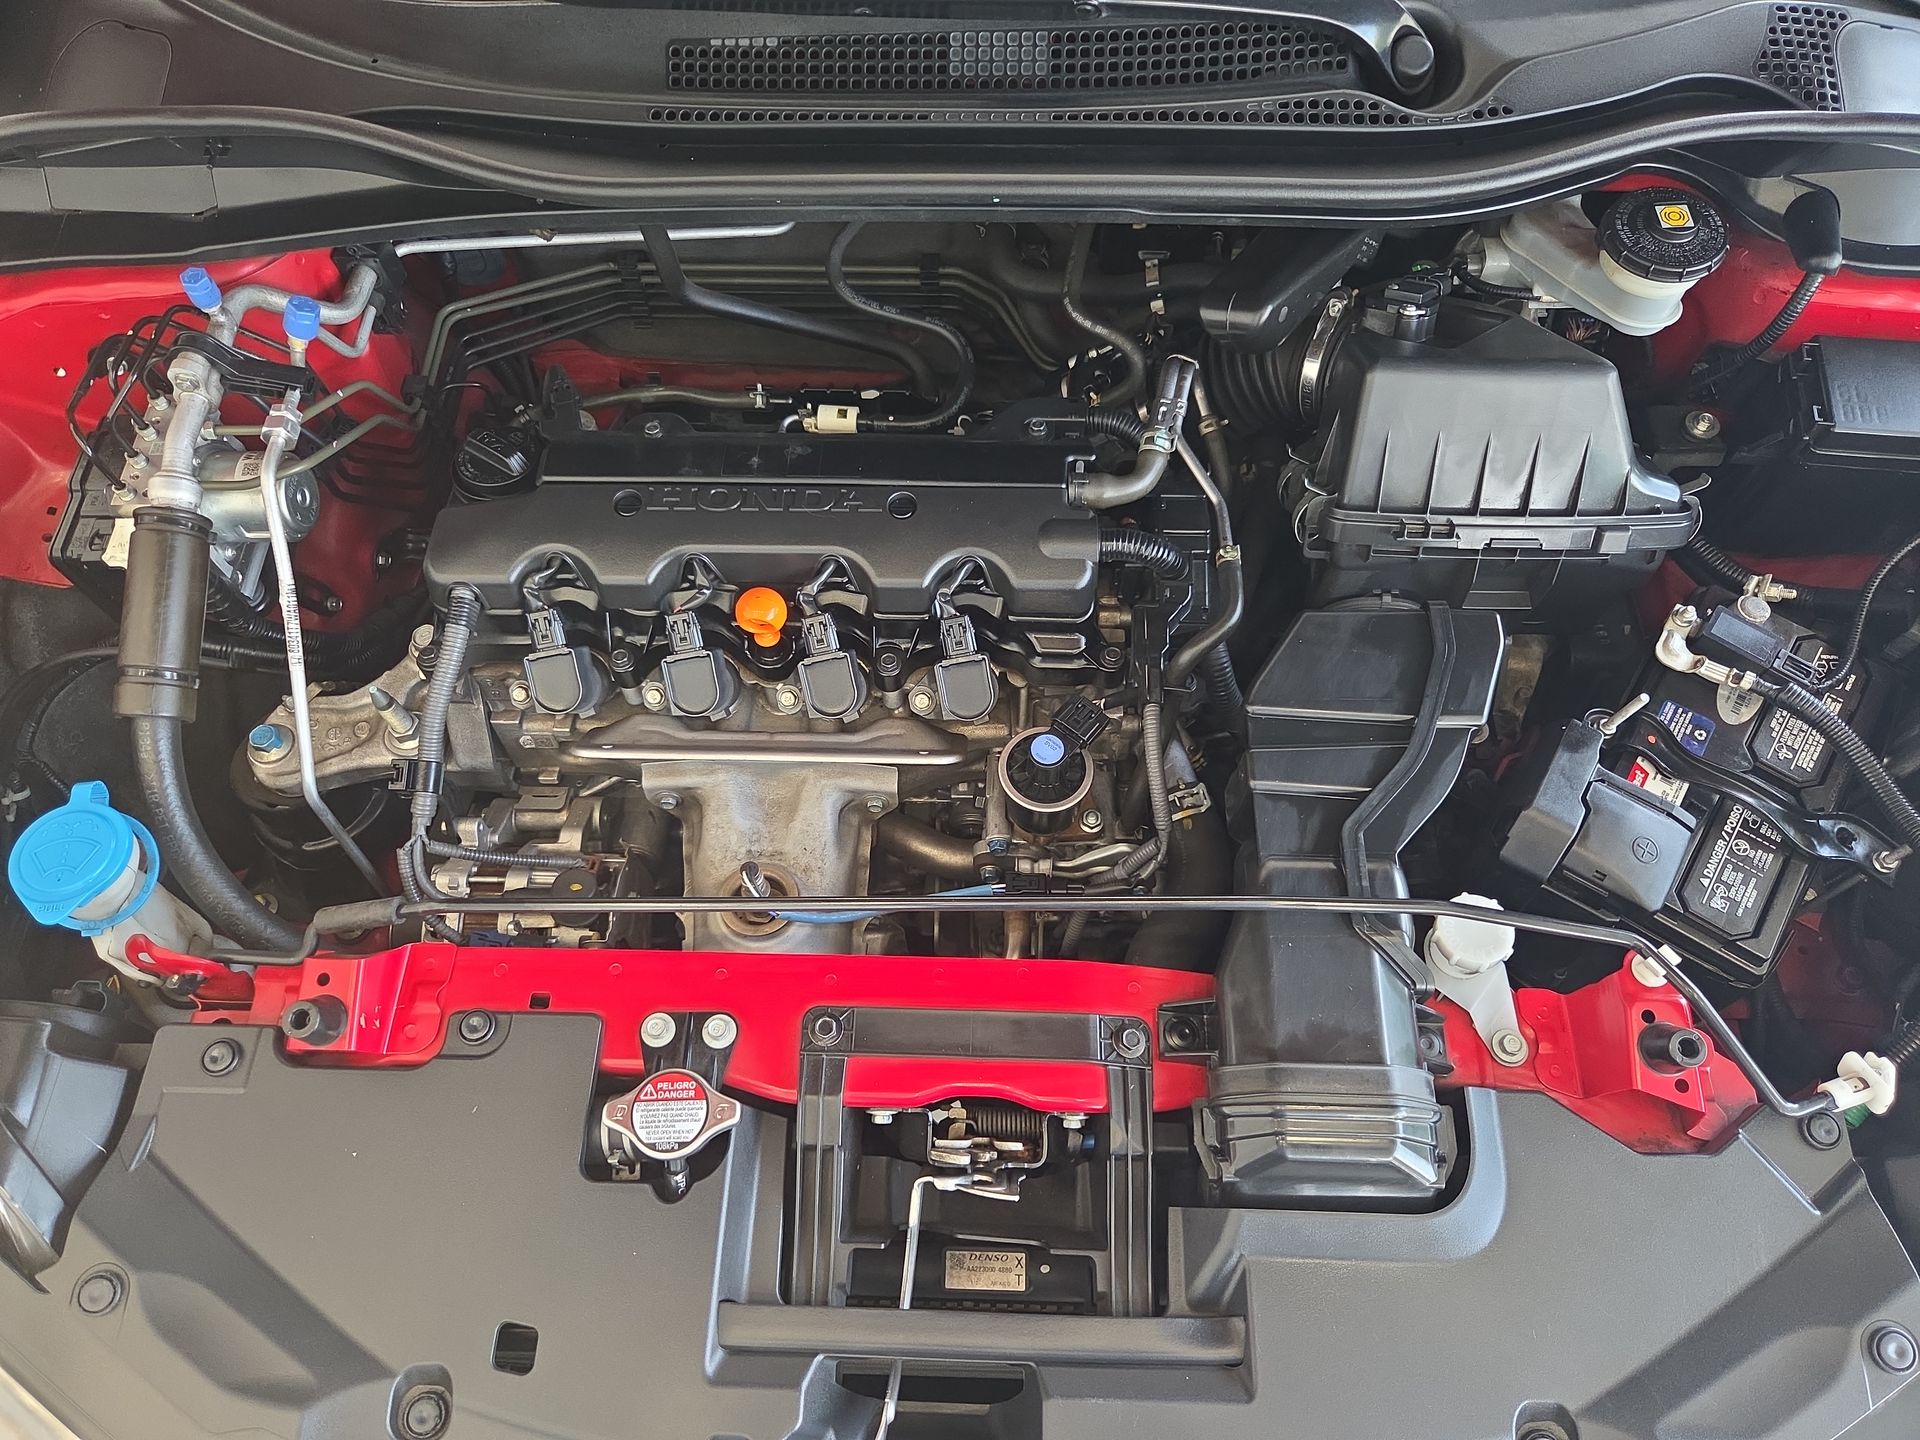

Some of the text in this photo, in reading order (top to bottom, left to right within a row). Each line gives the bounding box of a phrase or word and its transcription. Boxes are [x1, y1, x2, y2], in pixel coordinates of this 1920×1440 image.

[647, 487, 882, 512] HONDA
[1704, 840, 1727, 878] DANGER
[1724, 804, 1744, 833] POISO
[1729, 872, 1744, 898] EXPLOSIVE
[1735, 885, 1746, 901] GASES
[657, 1081, 696, 1090] PELIGRO
[658, 1090, 696, 1098] DANGER
[655, 1141, 679, 1150] 108kPa
[969, 1253, 1009, 1262] DENSO
[1015, 1256, 1024, 1268] X
[1014, 1274, 1024, 1286] T
